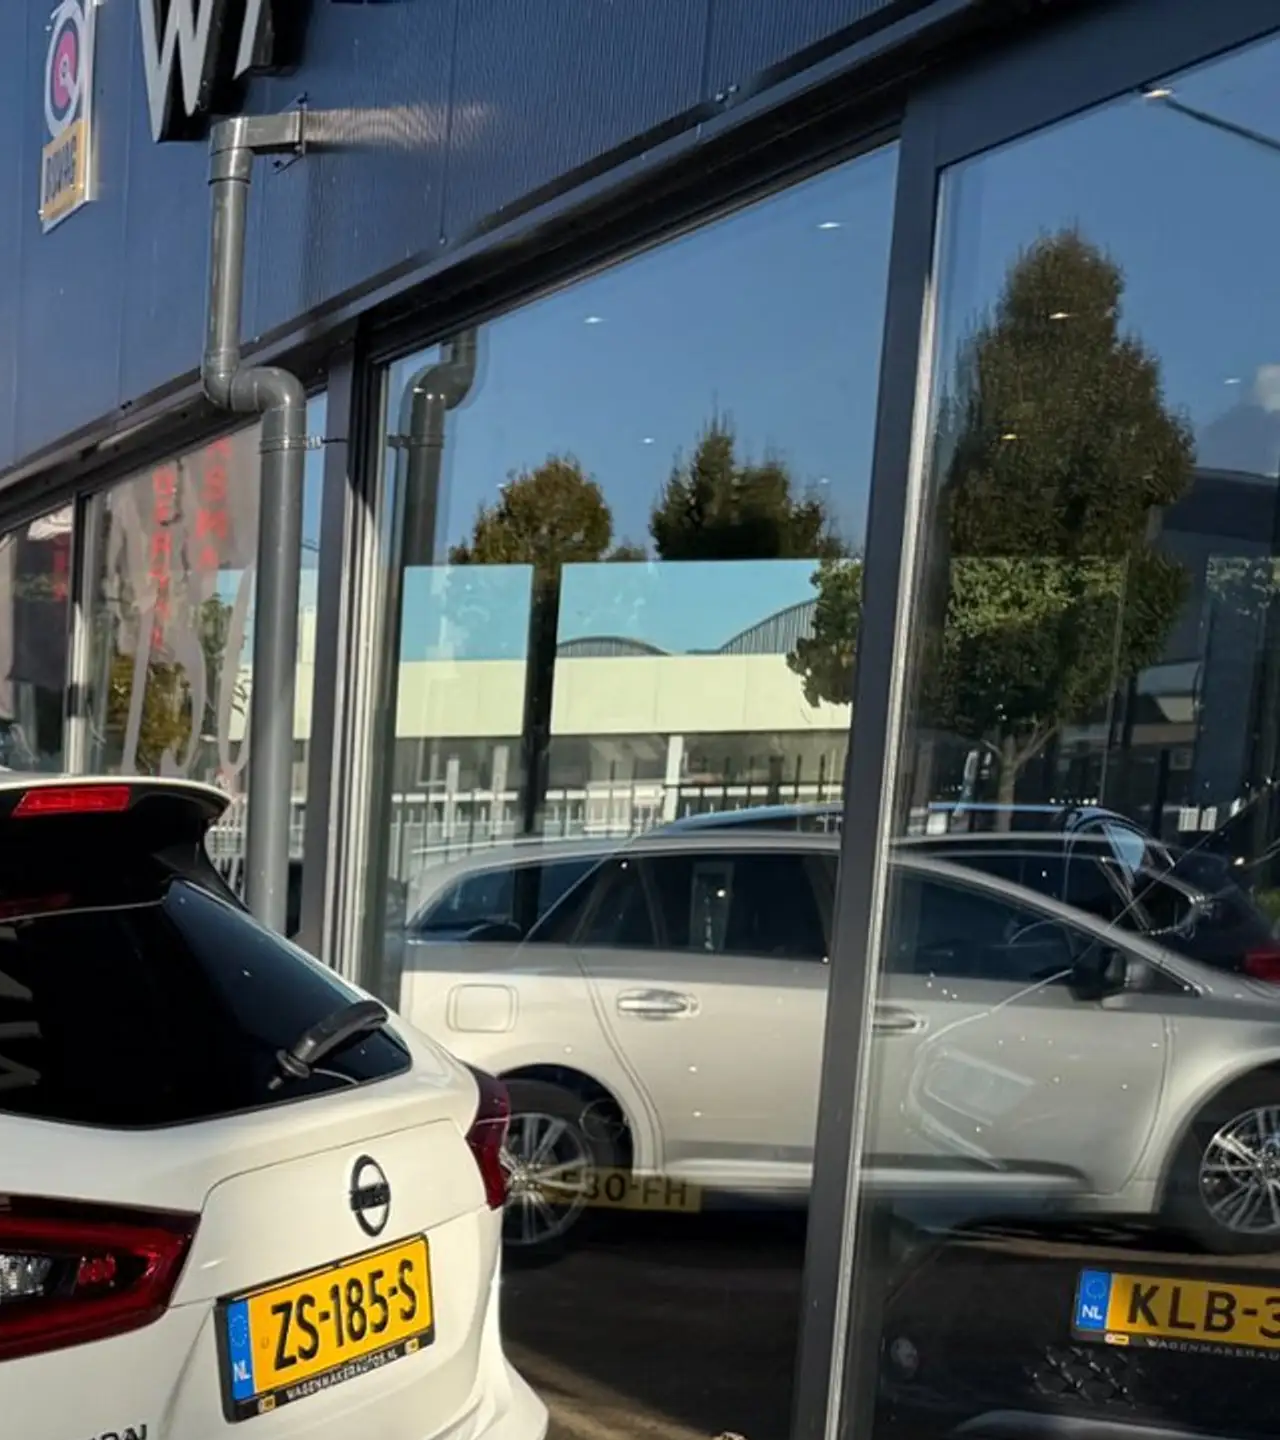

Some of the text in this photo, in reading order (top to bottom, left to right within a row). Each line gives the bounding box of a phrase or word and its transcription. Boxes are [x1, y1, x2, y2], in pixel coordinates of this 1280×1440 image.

[271, 1258, 418, 1372] ZS-185-S
[1081, 1303, 1103, 1320] NL
[232, 1359, 252, 1383] NL
